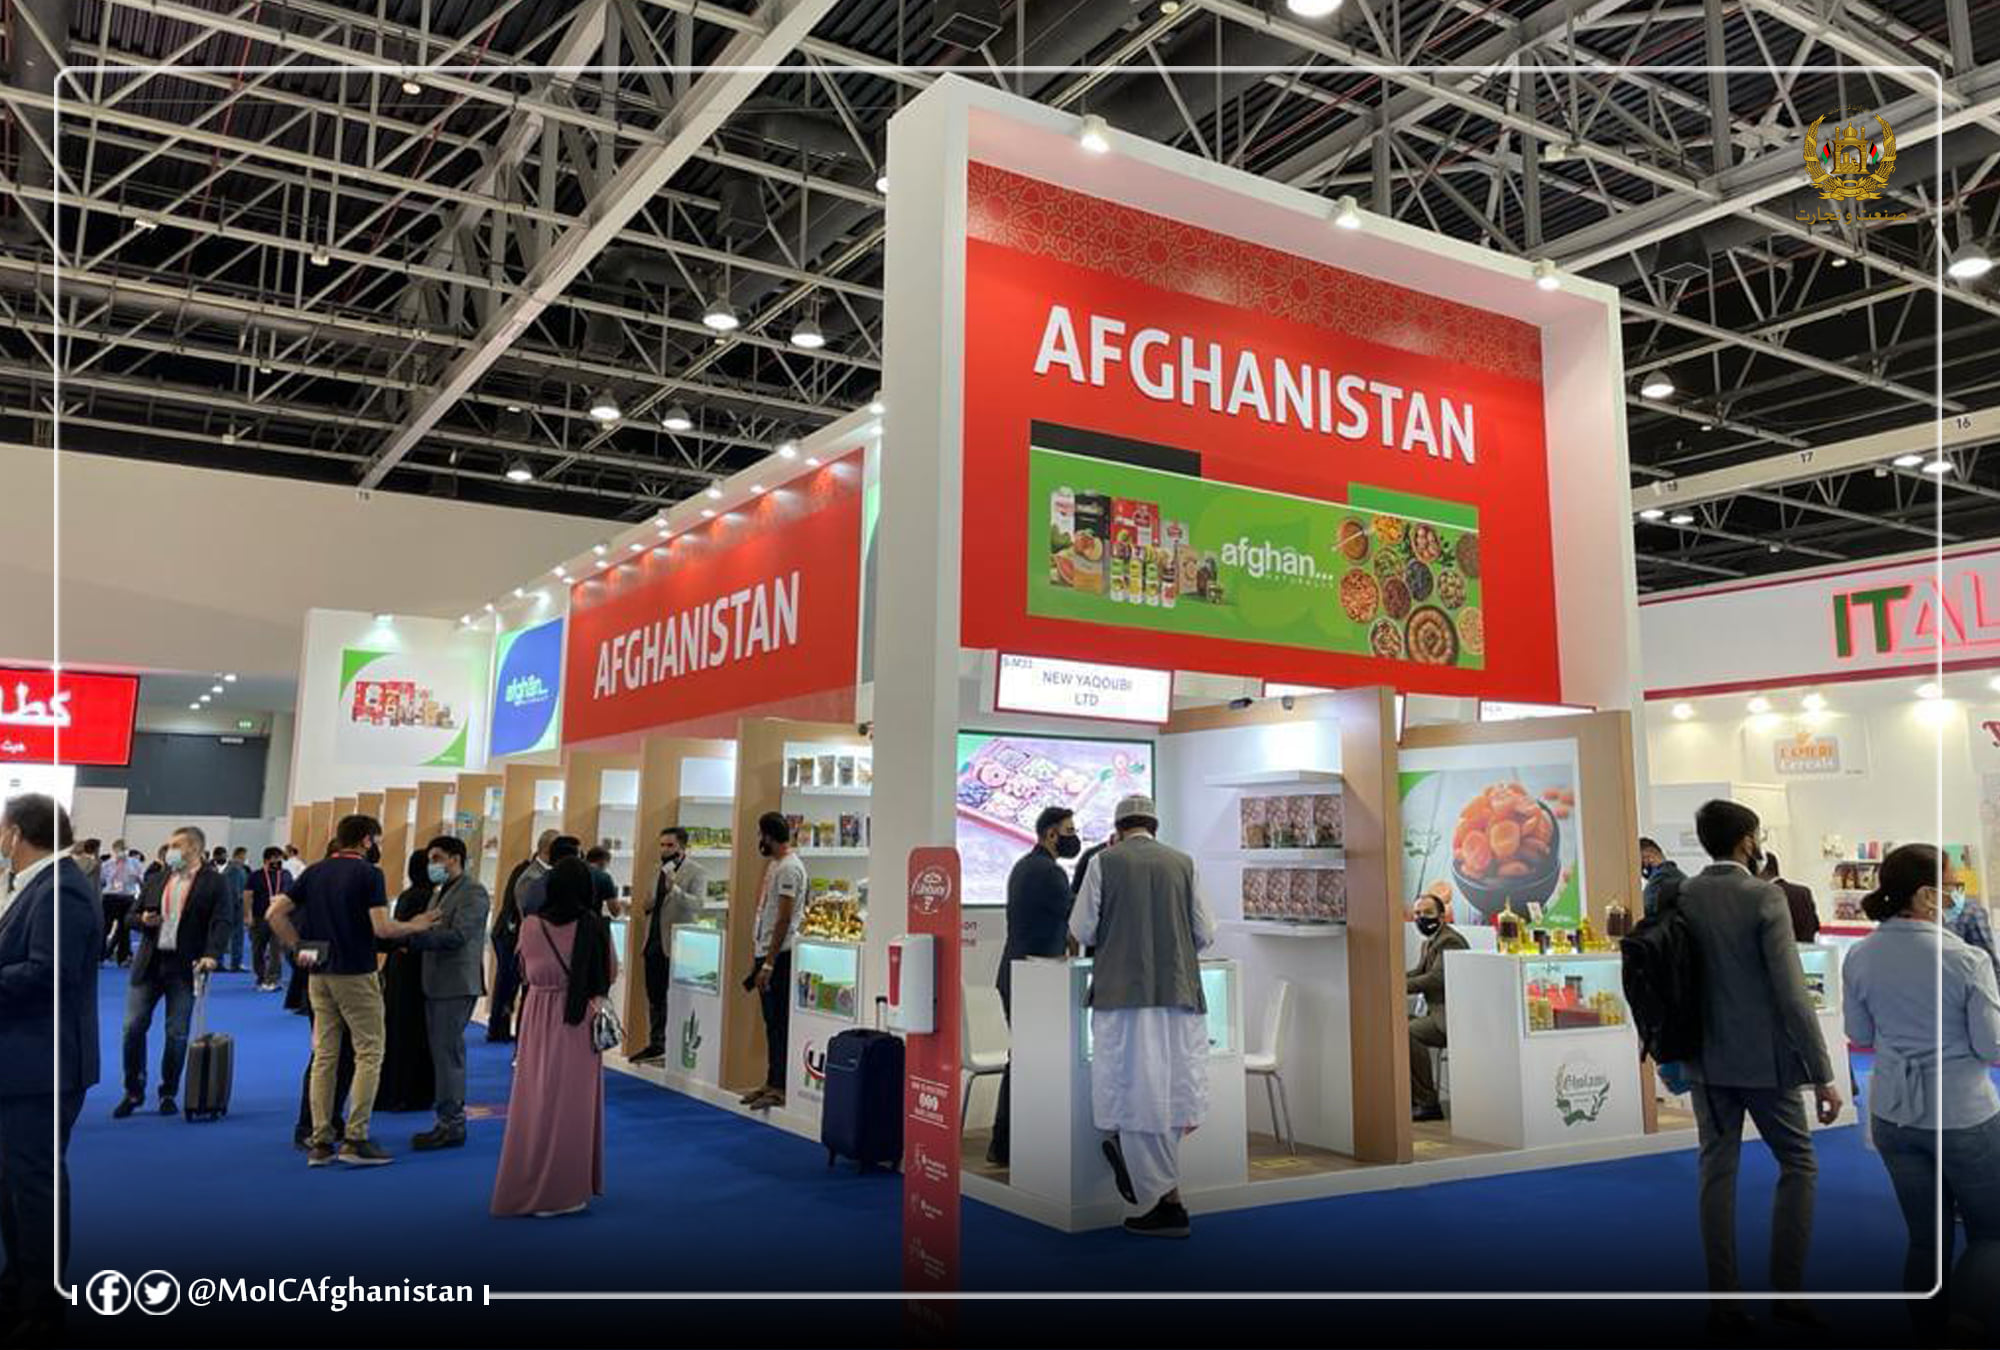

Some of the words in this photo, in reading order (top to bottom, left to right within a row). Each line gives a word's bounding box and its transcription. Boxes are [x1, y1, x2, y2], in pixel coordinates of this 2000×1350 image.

[1033, 304, 1477, 465] AFGHANISTAN
[1956, 418, 1971, 430] 16
[1800, 451, 1813, 463] 17
[593, 570, 799, 700] AFGHANISTAN
[1042, 671, 1073, 685] NEW
[1077, 674, 1132, 692] YAQOUBI
[1074, 693, 1099, 707] LTD
